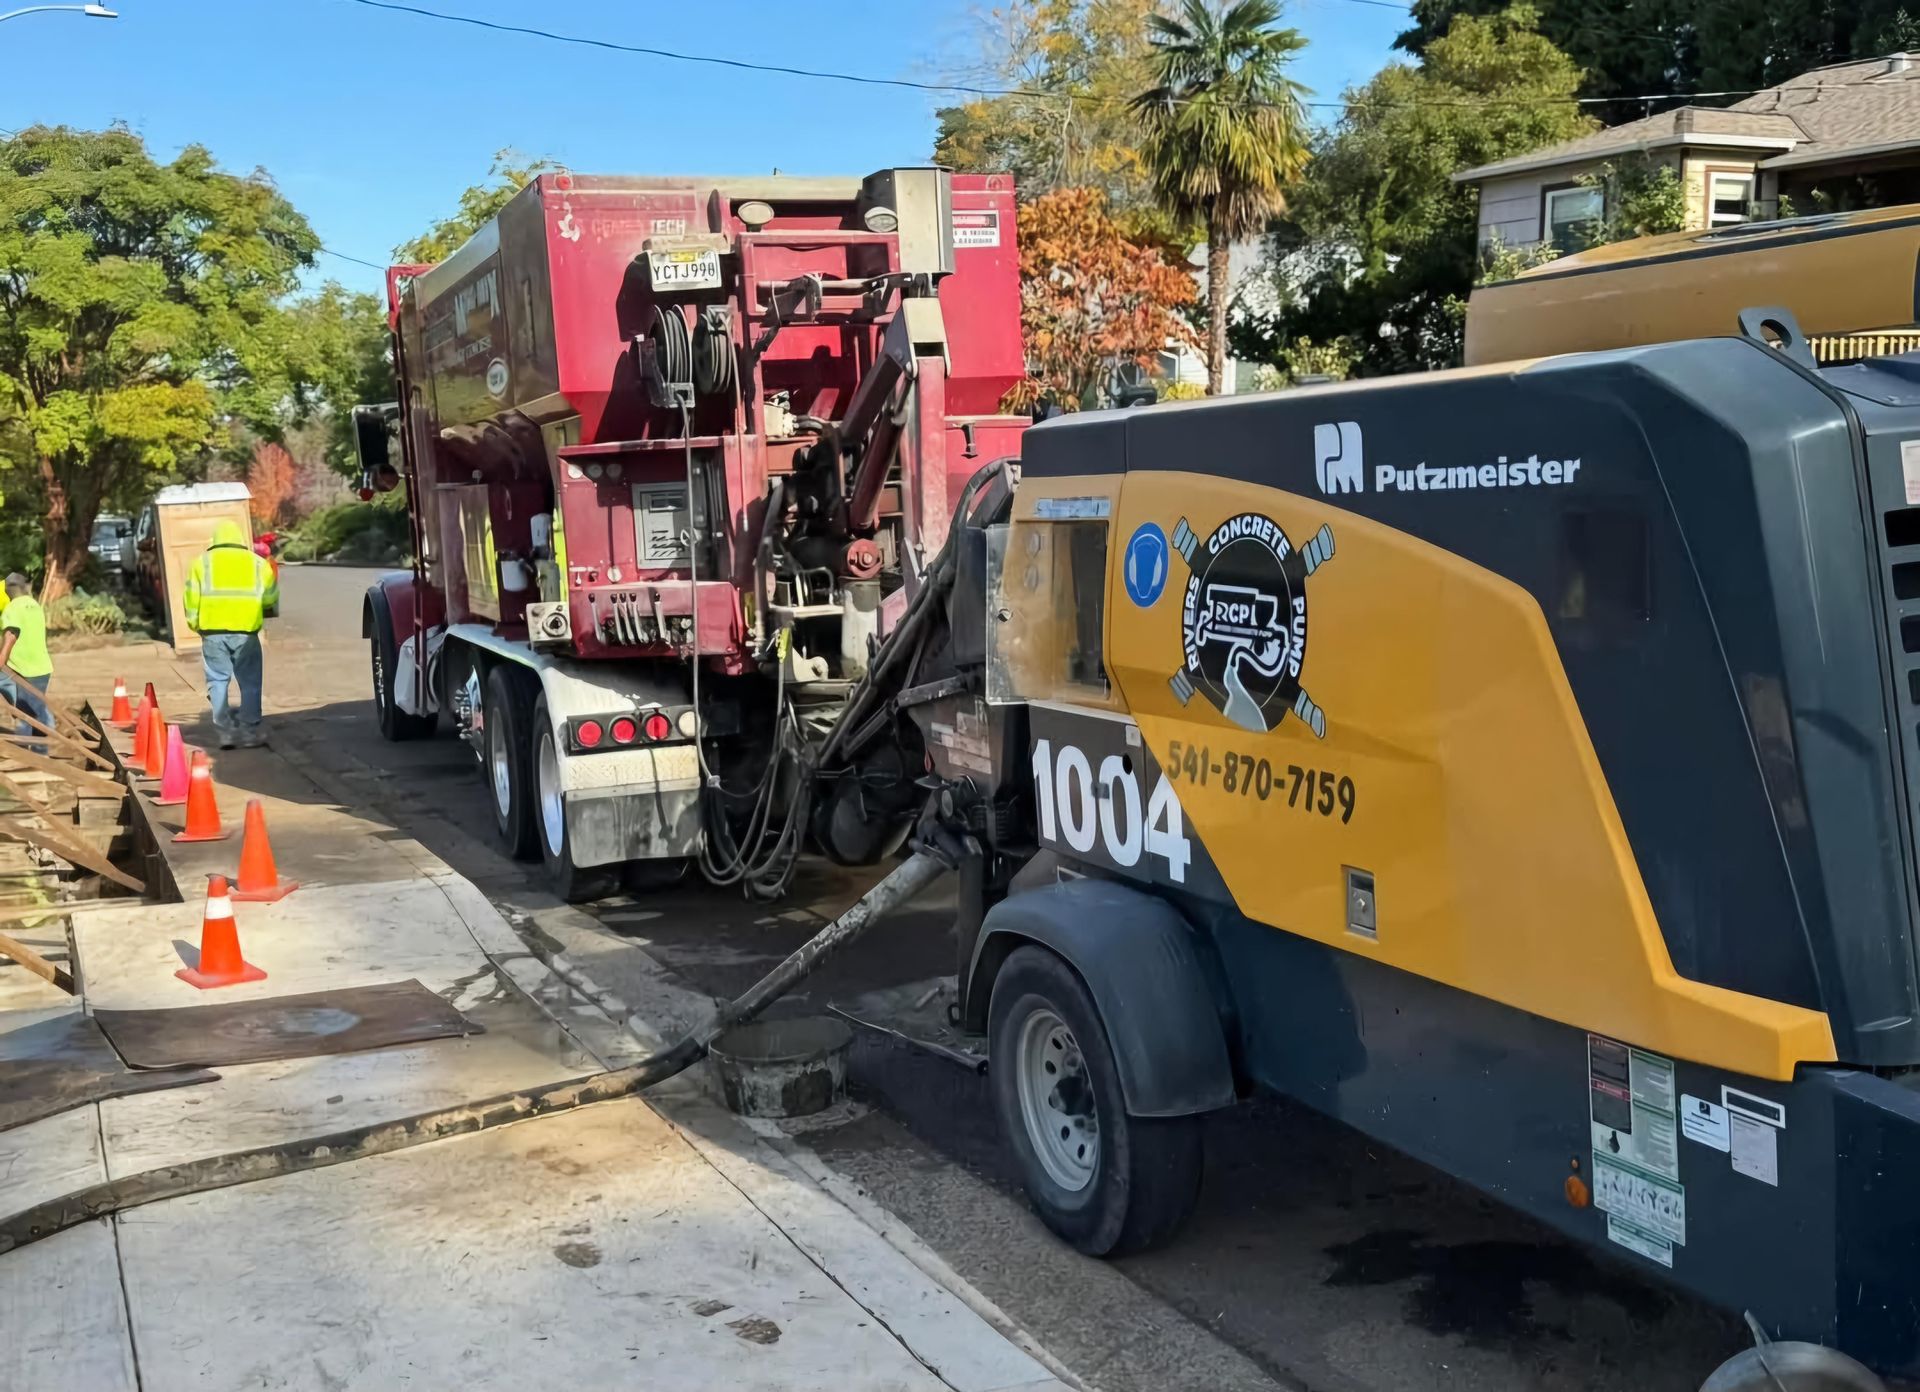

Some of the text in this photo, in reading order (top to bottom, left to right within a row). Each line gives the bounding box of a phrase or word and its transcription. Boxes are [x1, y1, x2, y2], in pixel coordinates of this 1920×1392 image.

[1376, 454, 1580, 492] Putzmeister
[1208, 515, 1291, 561] CONCRETE
[1184, 576, 1200, 672] RIVERS
[1290, 596, 1305, 677] PUMP
[1032, 739, 1192, 884] 1004
[1167, 740, 1356, 826] 541-870-7159
